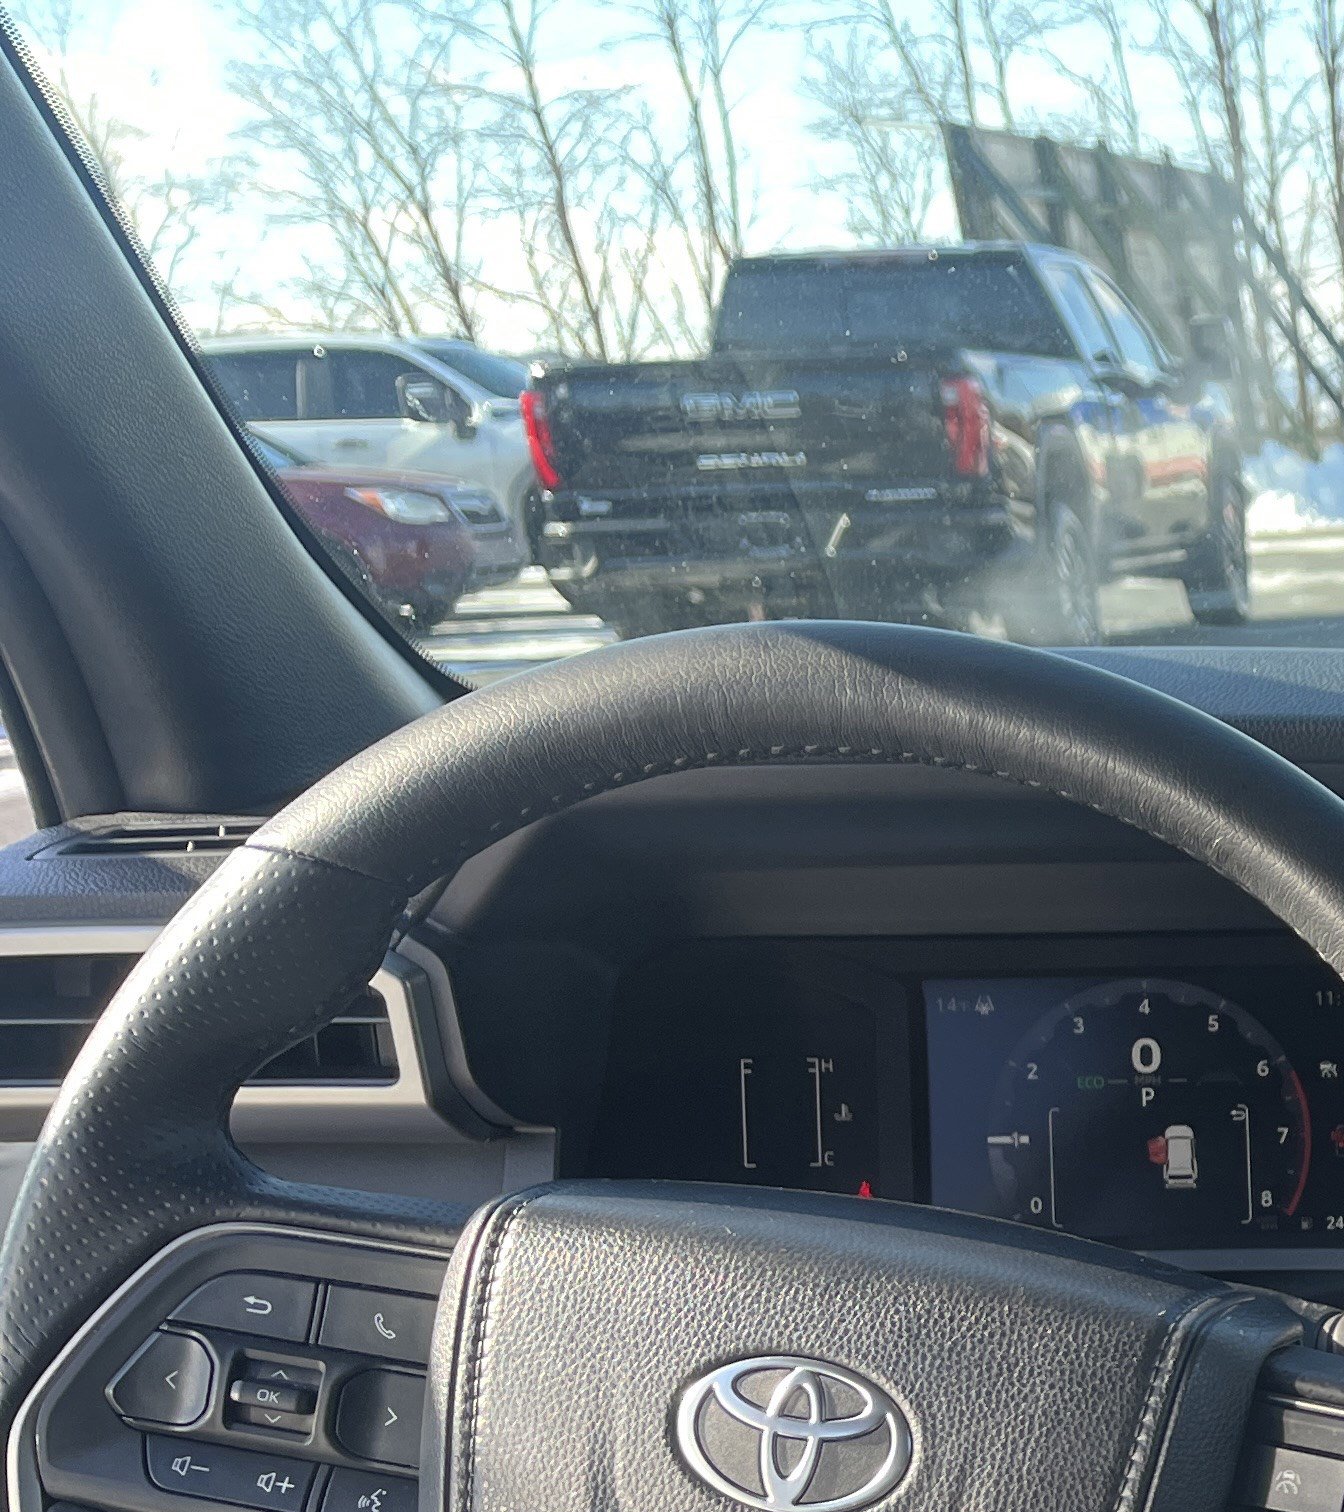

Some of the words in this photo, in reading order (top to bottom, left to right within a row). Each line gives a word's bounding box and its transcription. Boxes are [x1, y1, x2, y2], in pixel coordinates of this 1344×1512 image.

[1138, 998, 1151, 1015] 4
[1072, 1016, 1085, 1034] 3
[1207, 1014, 1219, 1032] 5
[1131, 1037, 1162, 1074] 0
[1026, 1062, 1039, 1080] 2
[1256, 1060, 1270, 1077] 6
[1077, 1075, 1104, 1089] ECO
[1141, 1087, 1155, 1107] P
[1276, 1126, 1289, 1144] 7
[1029, 1196, 1043, 1214] 0
[1260, 1189, 1273, 1208] 8
[256, 1388, 282, 1405] OK
